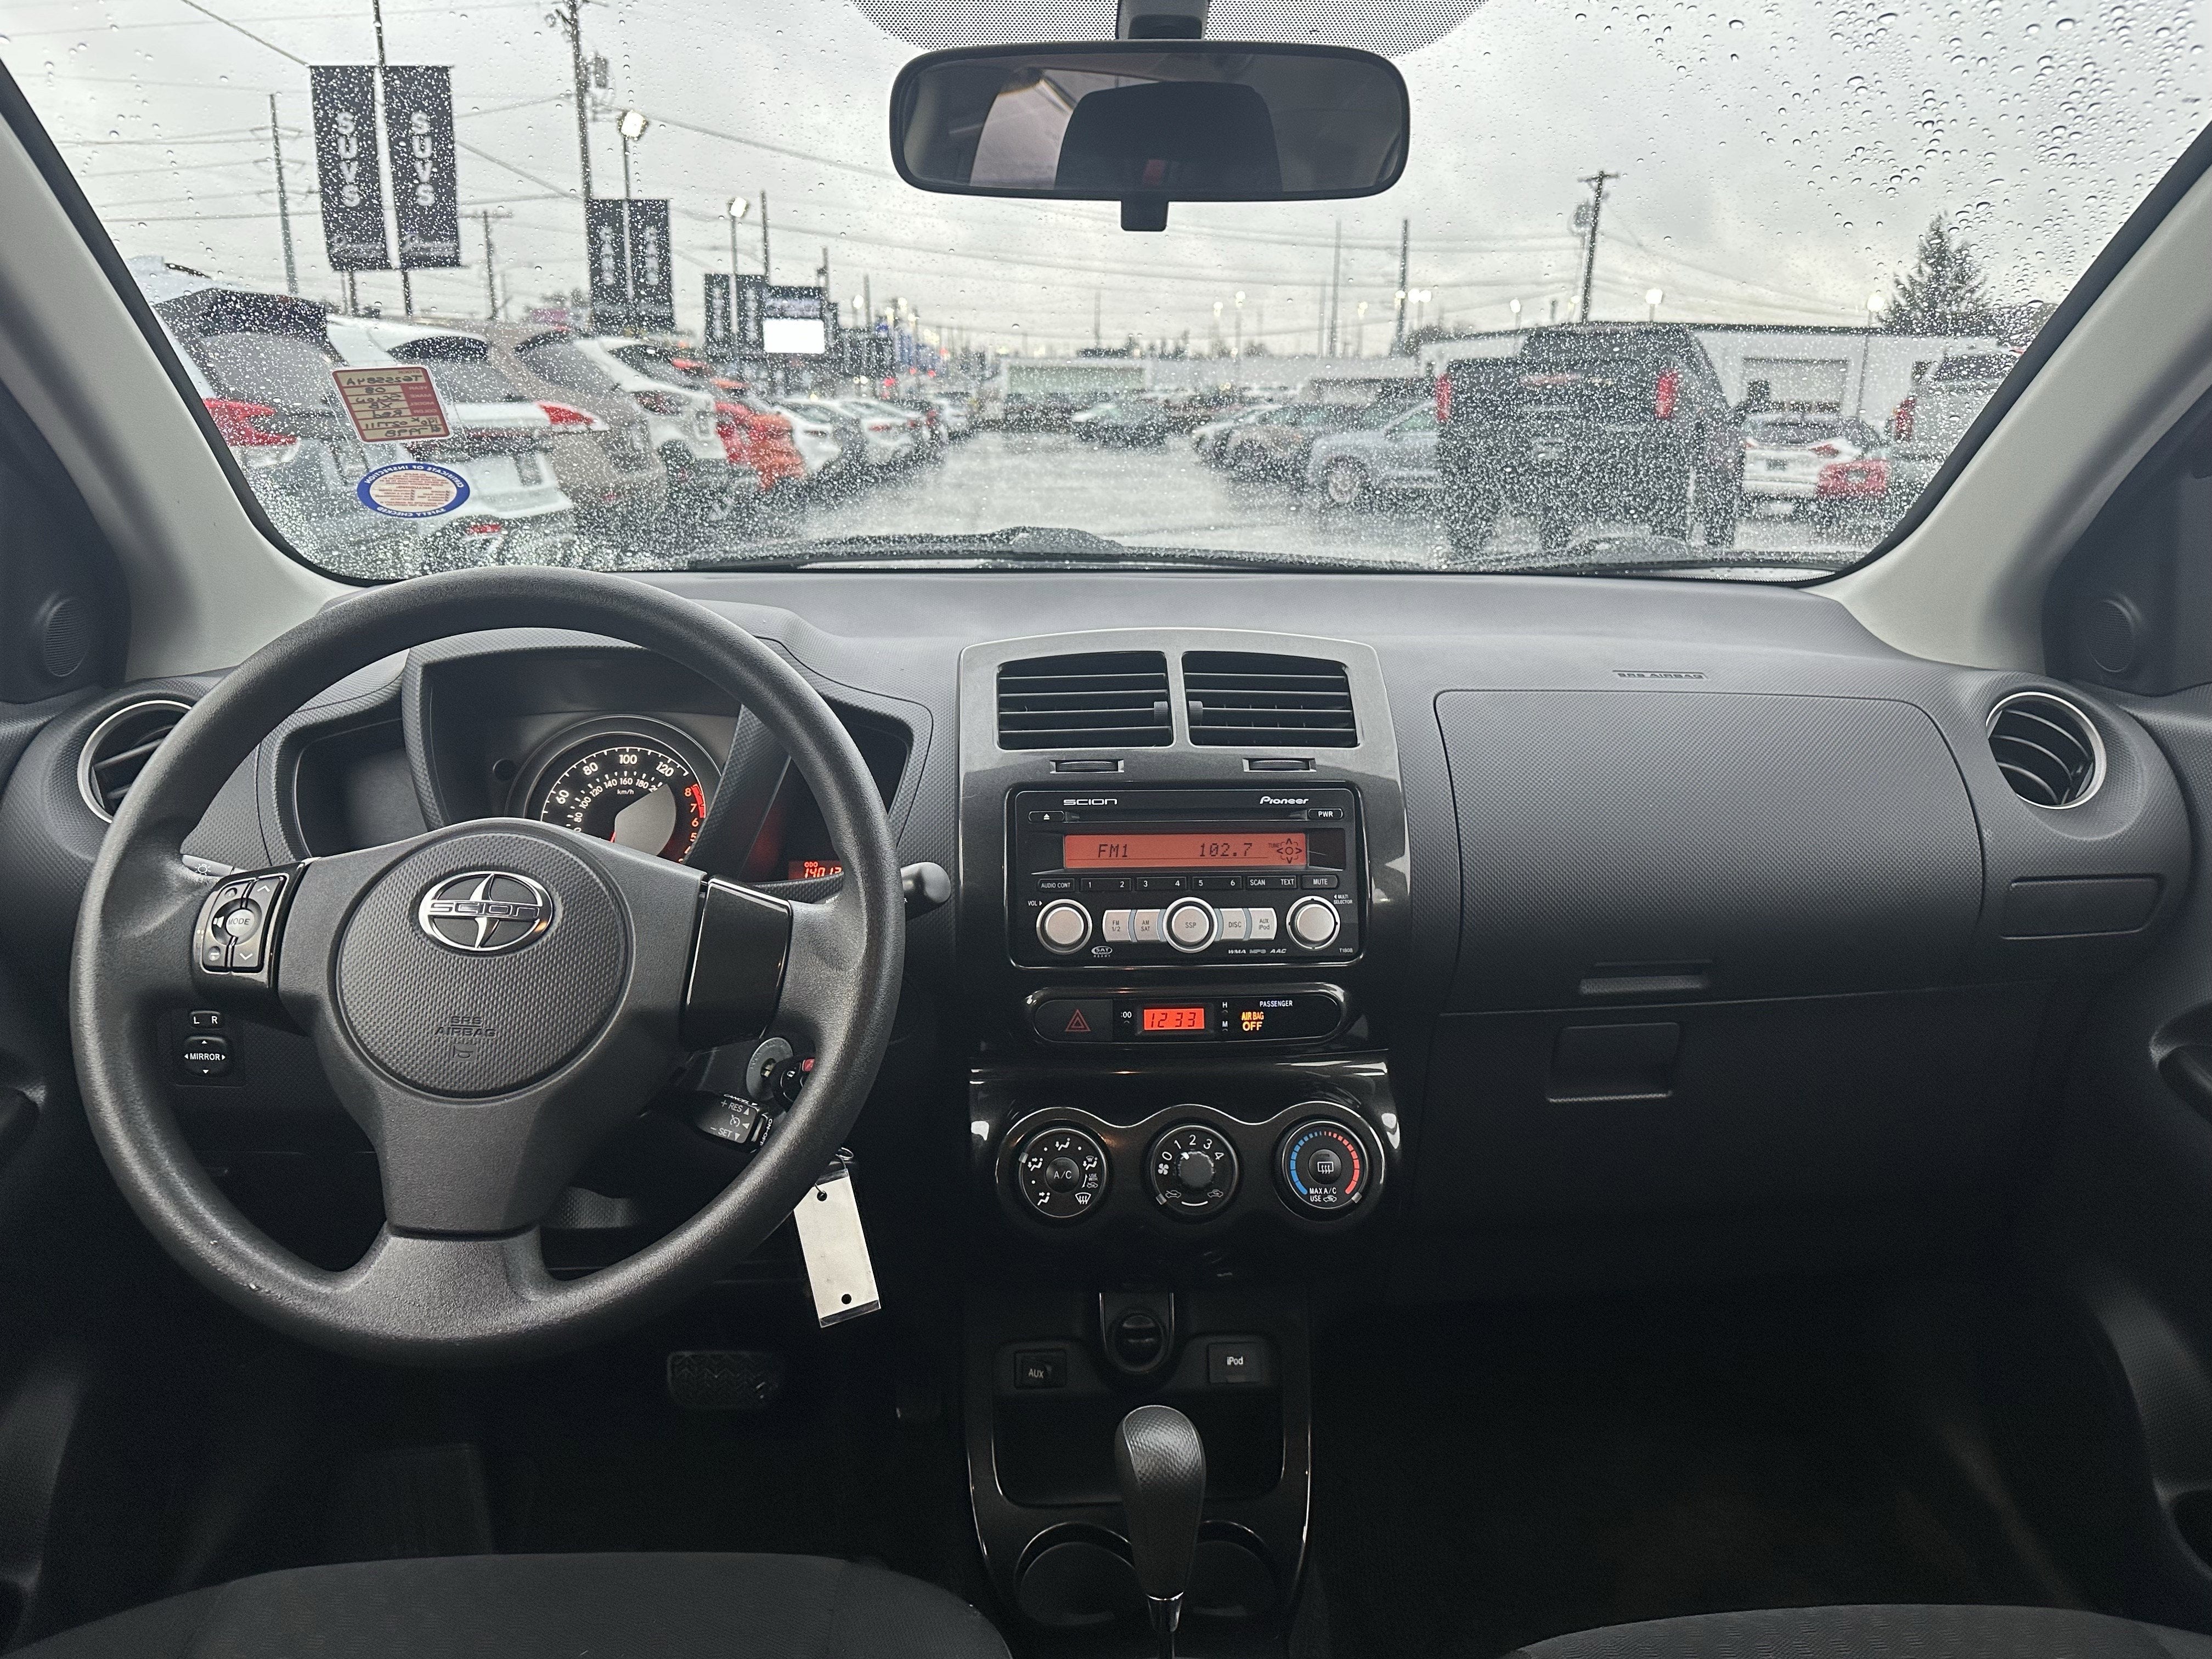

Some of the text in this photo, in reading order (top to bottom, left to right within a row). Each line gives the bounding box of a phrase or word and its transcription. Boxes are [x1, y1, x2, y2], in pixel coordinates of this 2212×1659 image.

[619, 754, 637, 765] 100
[582, 762, 599, 776] 80
[656, 761, 674, 777] 120
[603, 778, 617, 789] 140
[635, 778, 648, 789] 180
[556, 789, 569, 804] 60
[589, 786, 603, 797] 120
[685, 787, 691, 797] 8
[579, 796, 591, 809] 100
[1260, 796, 1309, 804] Pioneer
[691, 803, 697, 812] 7
[574, 812, 583, 823] 80
[692, 817, 698, 827] 6
[1098, 844, 1128, 858] FM1
[1200, 843, 1252, 856] 102.7
[194, 1015, 218, 1024] L R
[1242, 1012, 1264, 1020] AIR BAG
[1242, 1021, 1262, 1031] OFF
[729, 1102, 743, 1113] RES
[718, 1127, 732, 1138] SET
[1174, 1140, 1181, 1149] 1
[1189, 1135, 1196, 1146] 2
[1203, 1139, 1212, 1149] 3
[1162, 1152, 1172, 1161] 0
[1054, 1170, 1072, 1180] A/C
[1227, 1356, 1244, 1365] iPod
[1029, 1369, 1044, 1378] AUX
